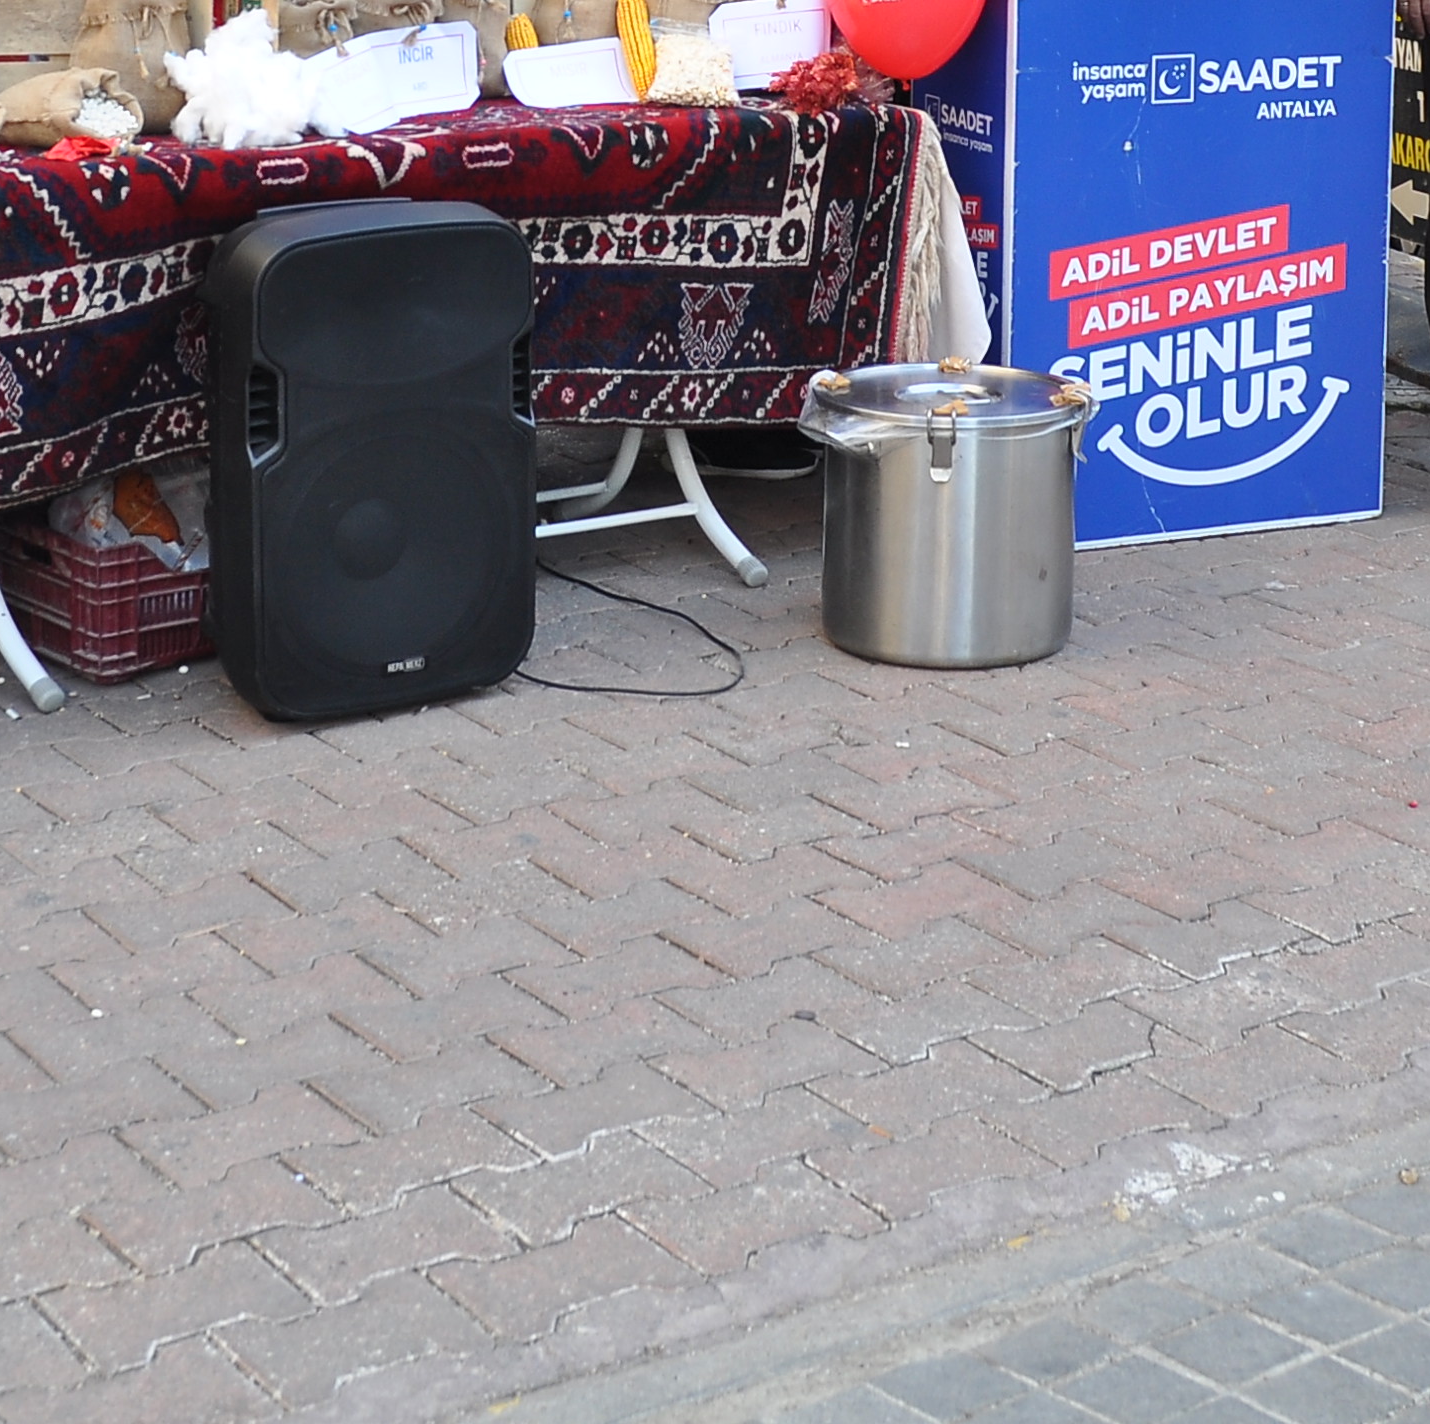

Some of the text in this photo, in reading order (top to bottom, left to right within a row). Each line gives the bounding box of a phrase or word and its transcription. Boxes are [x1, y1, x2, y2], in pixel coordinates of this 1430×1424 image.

[398, 44, 434, 65] İNCİR
[1072, 62, 1148, 81] insanca
[1198, 56, 1342, 94] SAADET
[1081, 81, 1146, 104] yaşam
[941, 103, 993, 137] SAADET
[1256, 99, 1337, 121] ANTALYA
[1148, 217, 1277, 269] DEVLET
[1169, 256, 1335, 318] PAYLAŞIM
[1135, 366, 1307, 448] OLUR
